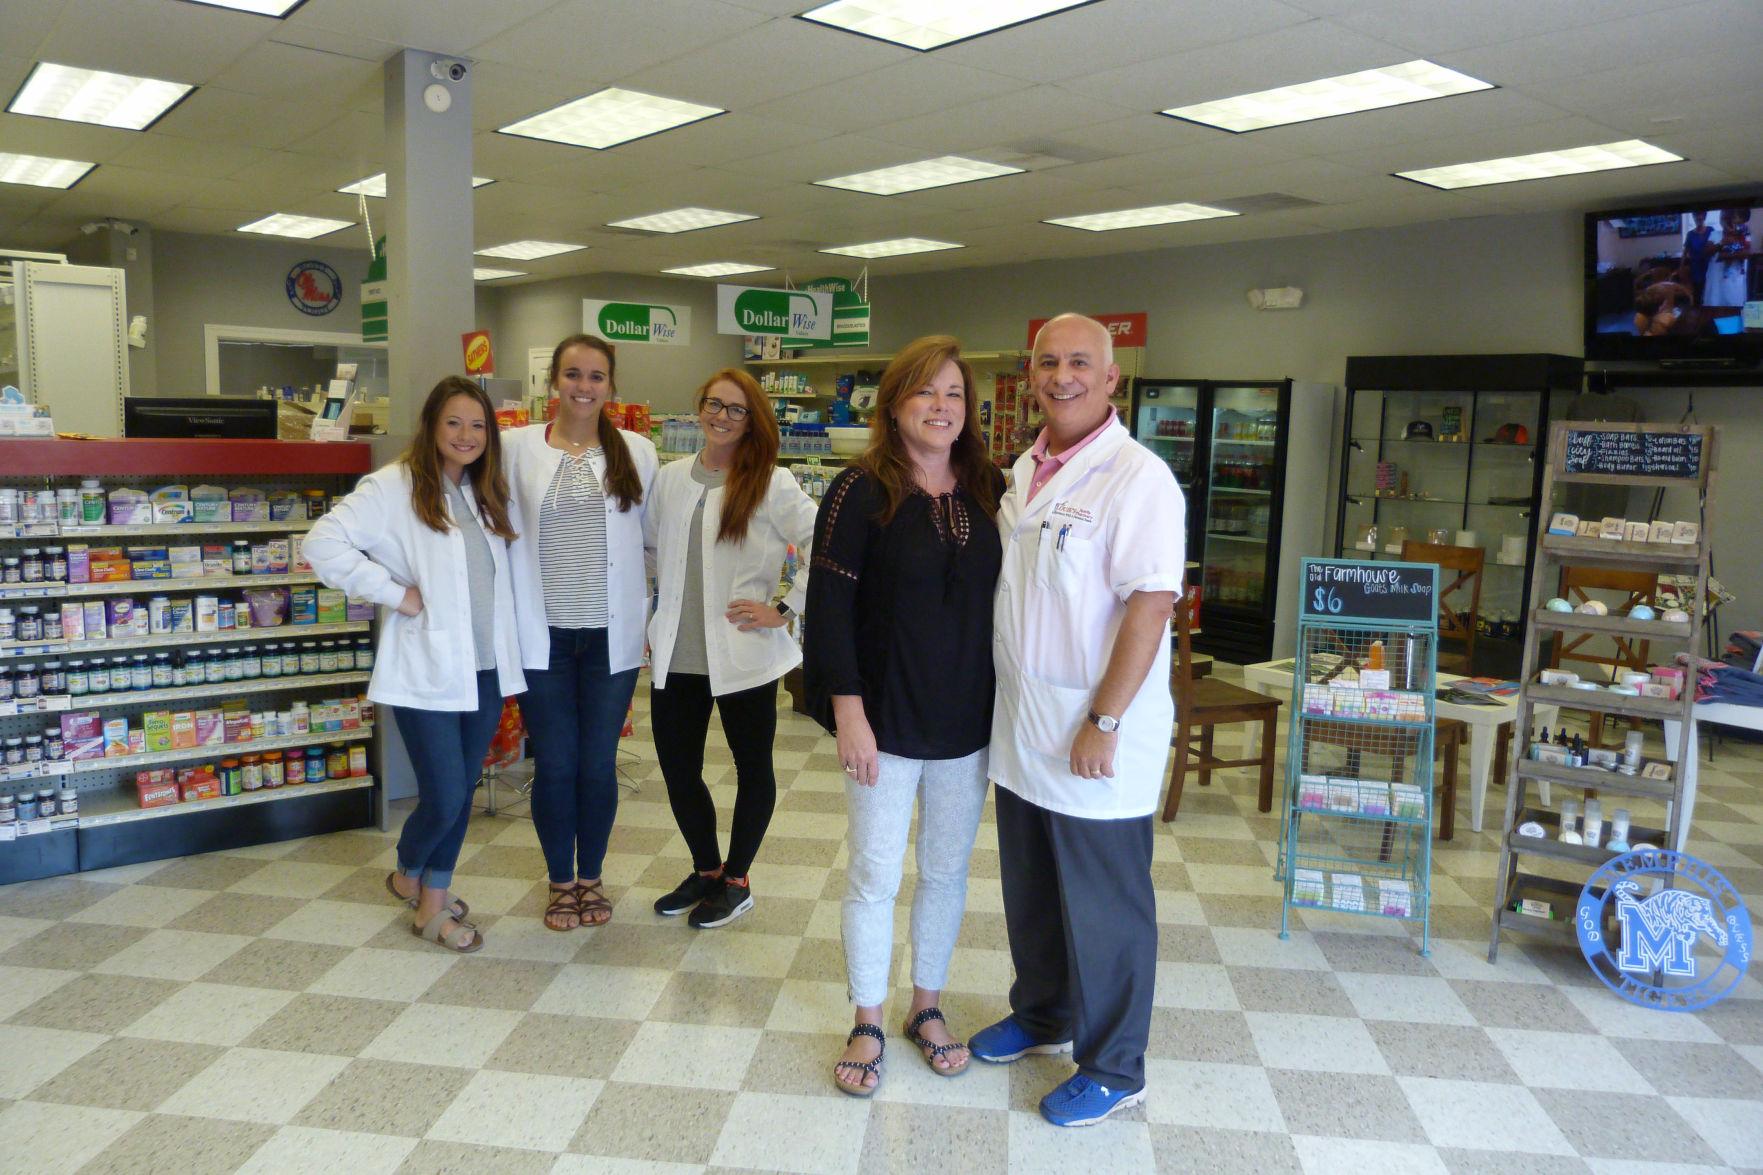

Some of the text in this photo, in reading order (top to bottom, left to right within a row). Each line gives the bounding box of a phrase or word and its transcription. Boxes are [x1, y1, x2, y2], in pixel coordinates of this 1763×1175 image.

[606, 319, 677, 338] Dollar Wise
[743, 309, 789, 328] Dollar
[792, 313, 817, 331] Wise
[1308, 564, 1323, 573] The
[1309, 565, 1401, 584] Old Farmhouse
[1363, 582, 1432, 596] Goats Milk Soap
[1312, 585, 1343, 614] $6
